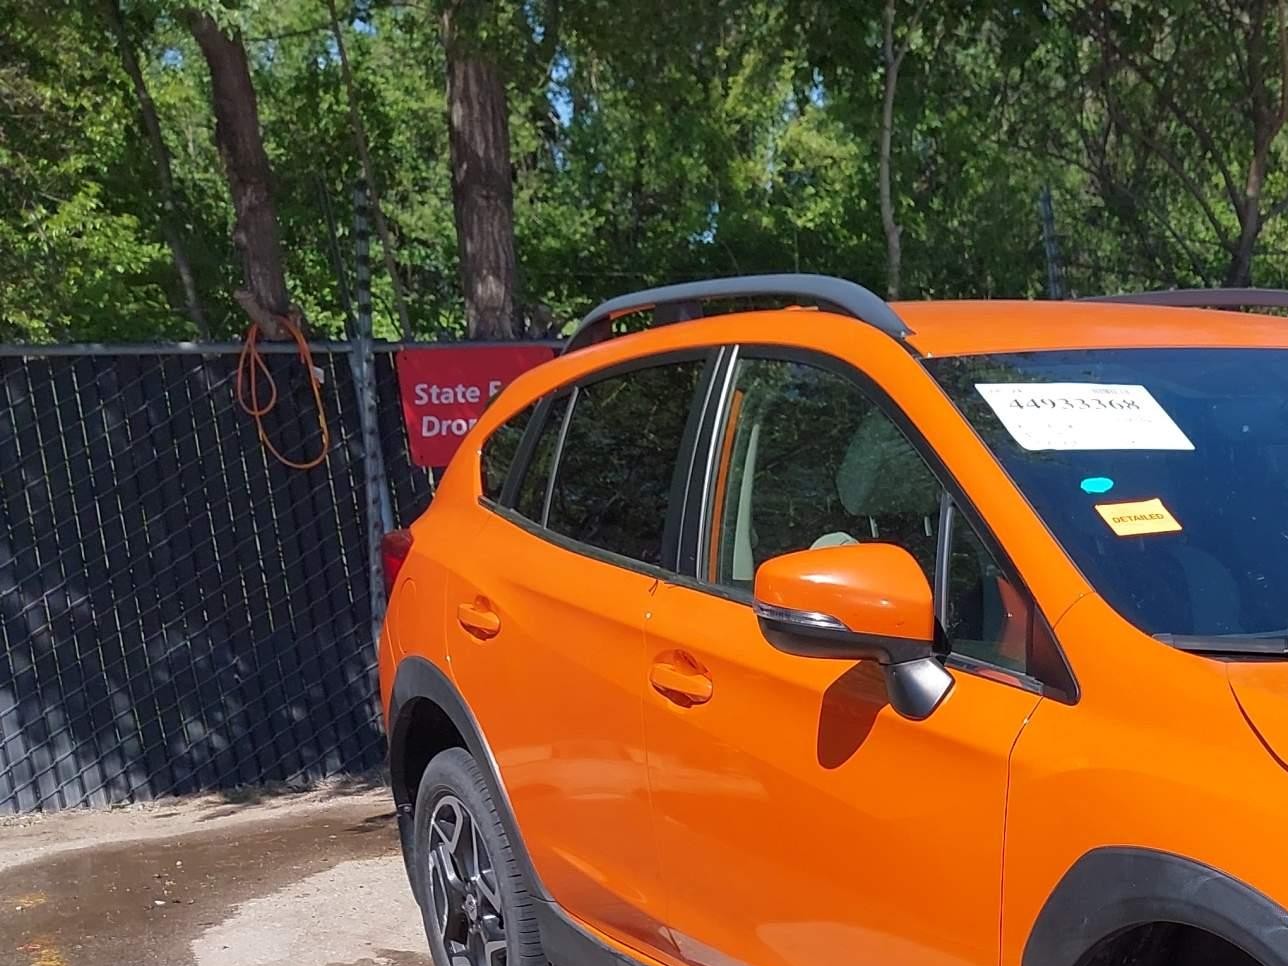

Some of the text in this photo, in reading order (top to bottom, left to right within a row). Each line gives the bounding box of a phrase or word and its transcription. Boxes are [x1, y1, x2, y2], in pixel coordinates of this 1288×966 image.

[414, 383, 480, 405] State
[1008, 398, 1142, 411] 44933368
[1111, 512, 1165, 525] DETAILED
